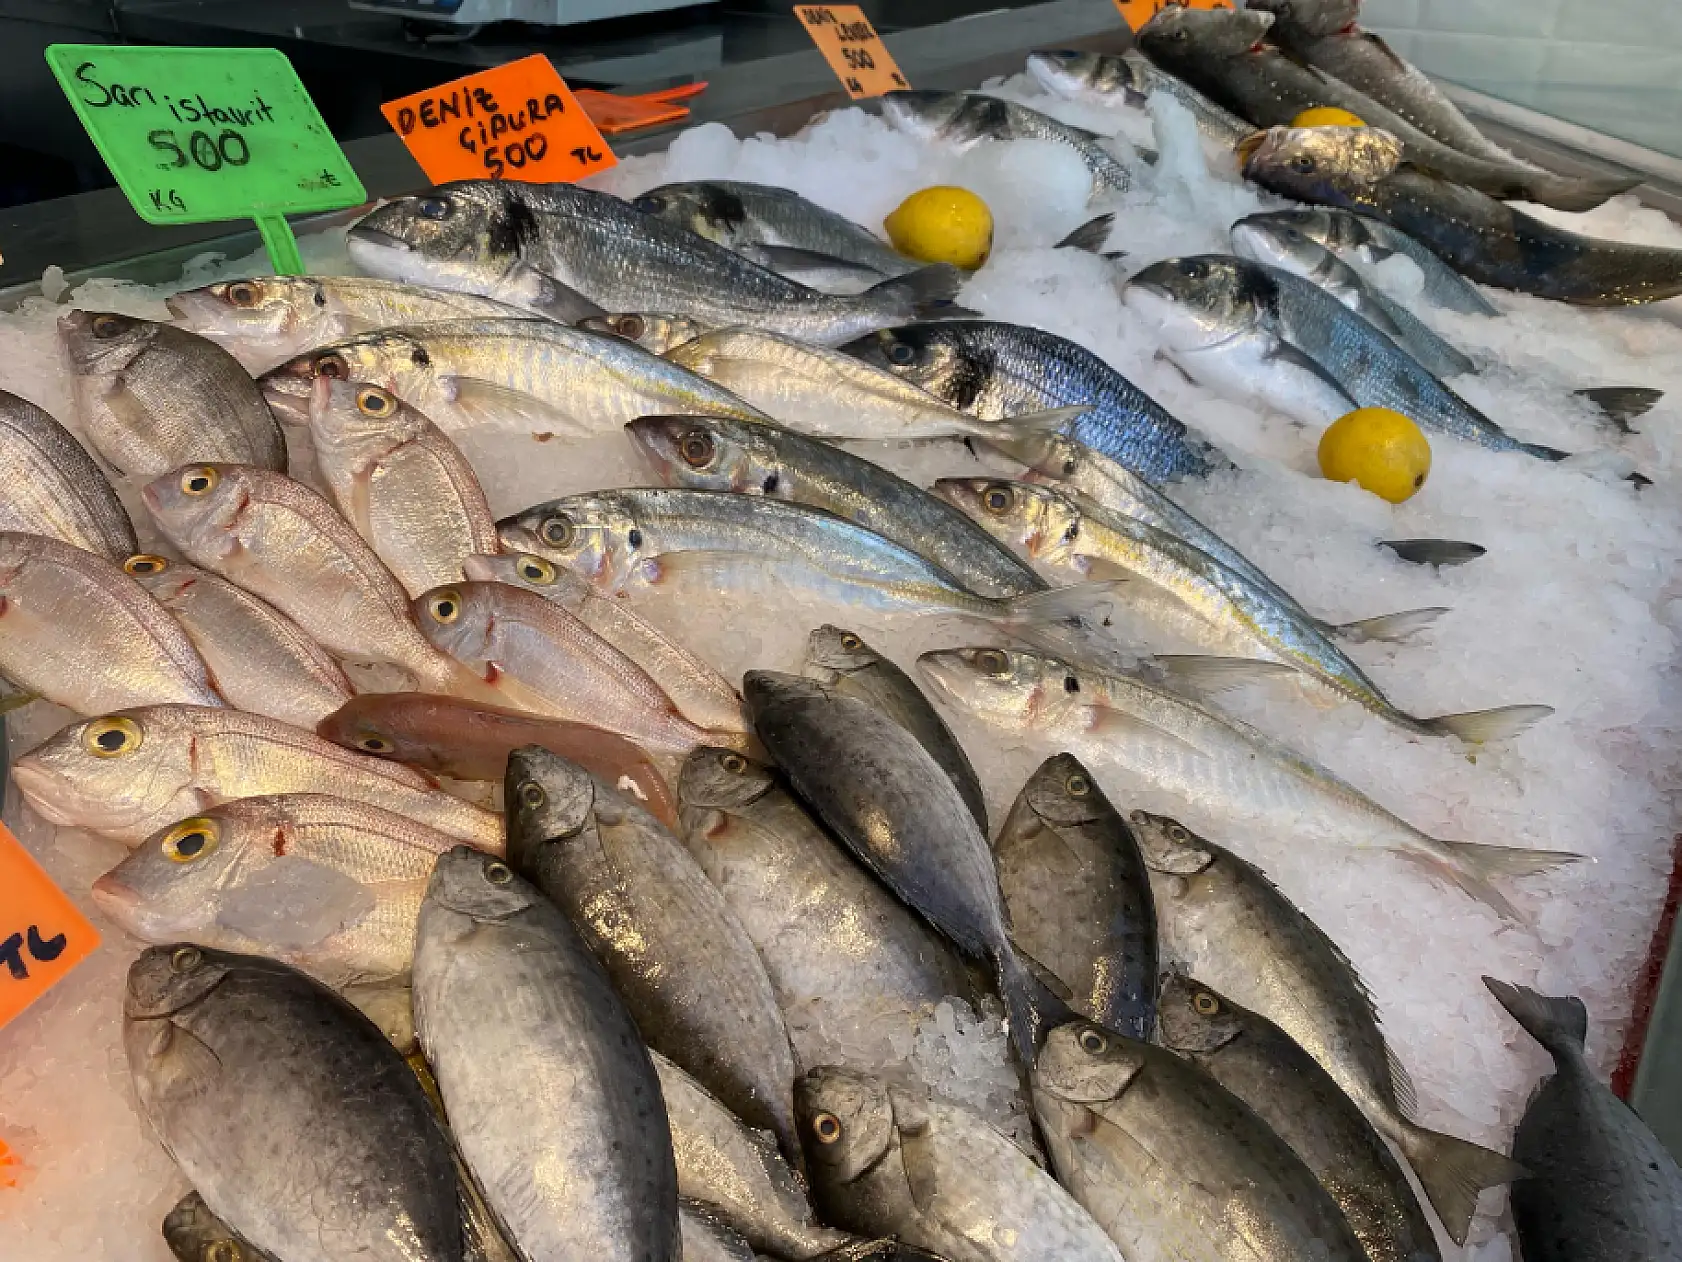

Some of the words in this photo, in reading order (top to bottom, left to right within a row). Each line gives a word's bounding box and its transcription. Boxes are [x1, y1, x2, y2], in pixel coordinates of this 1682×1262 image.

[147, 128, 250, 172] 500
[483, 132, 548, 181] 500
[0, 924, 67, 979] TL
